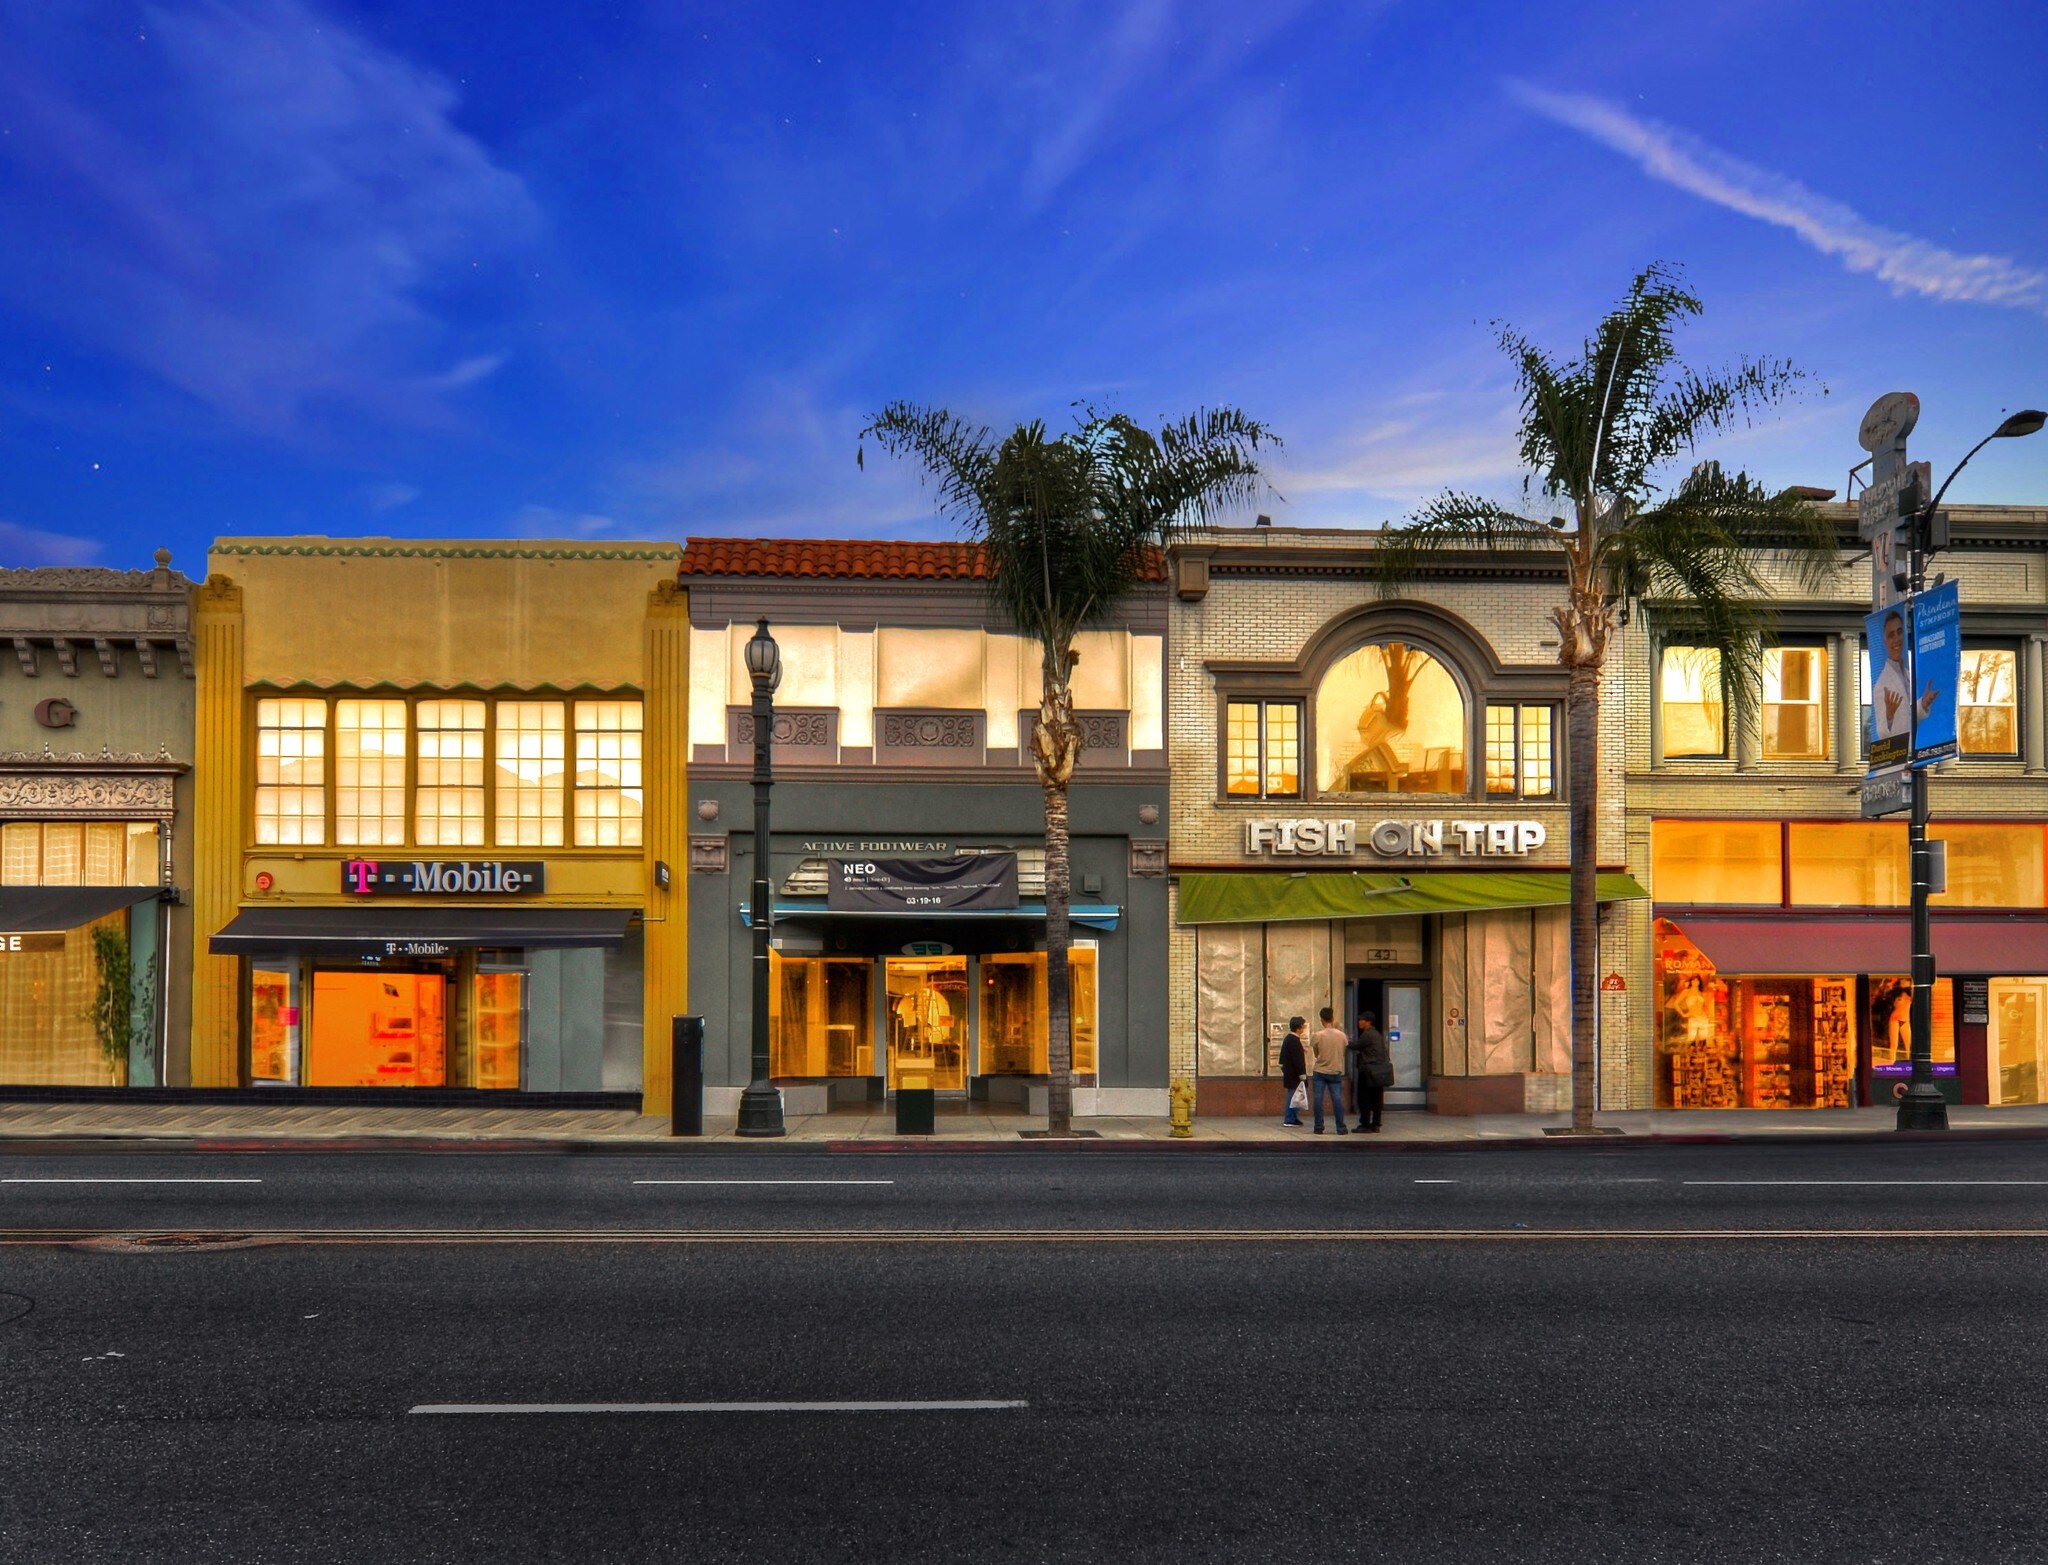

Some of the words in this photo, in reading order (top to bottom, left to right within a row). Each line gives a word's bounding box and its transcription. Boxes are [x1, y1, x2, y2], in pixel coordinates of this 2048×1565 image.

[1245, 818, 1356, 856] FISH
[1370, 818, 1444, 857] ON
[1452, 820, 1547, 857] TAP
[802, 841, 855, 851] ACTIVE
[860, 841, 947, 851] FOOTWEAR
[843, 863, 876, 874] NEO
